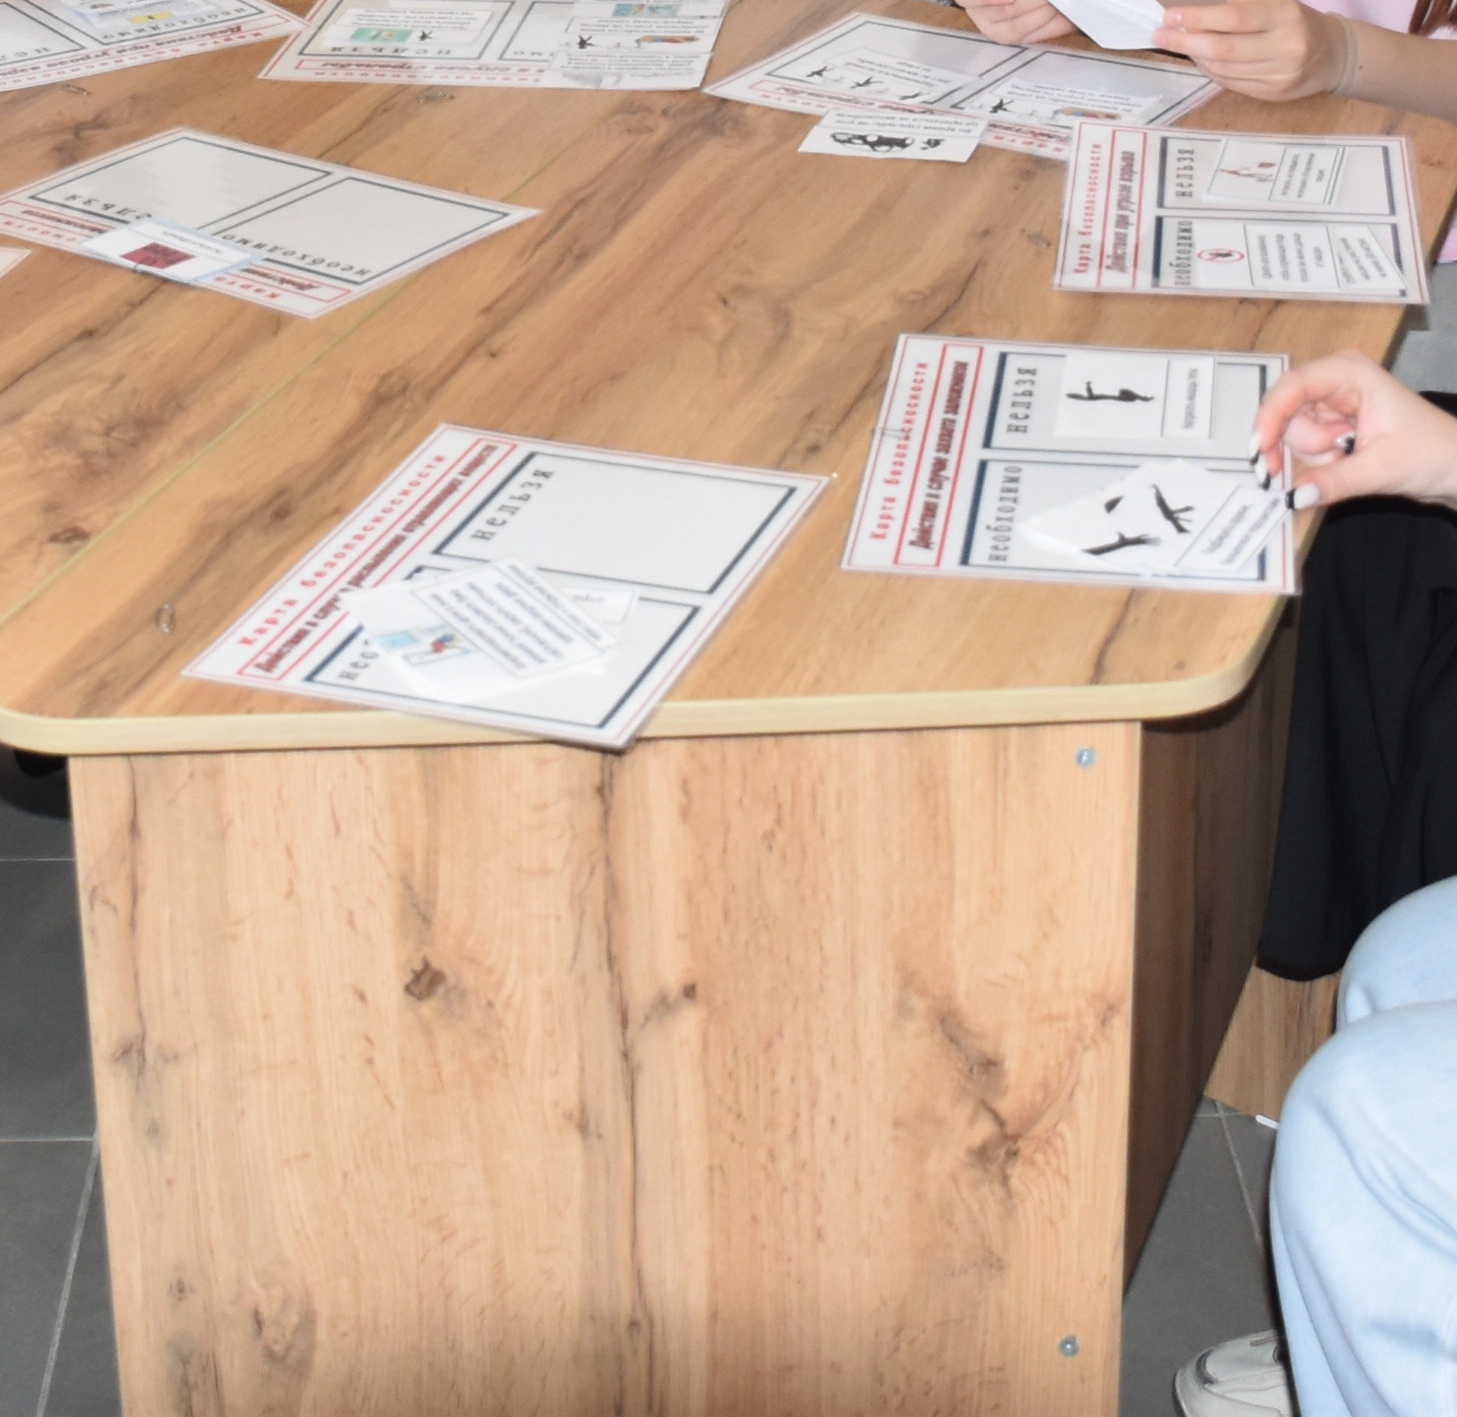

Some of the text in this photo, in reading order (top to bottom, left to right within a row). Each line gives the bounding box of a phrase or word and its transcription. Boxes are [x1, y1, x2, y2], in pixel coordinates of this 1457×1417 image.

[116, 44, 149, 54] при
[156, 24, 246, 46] Действия
[47, 49, 110, 67] угрозе
[1176, 149, 1195, 198] нельзя
[65, 195, 152, 219] ельзя
[1073, 243, 1092, 273] Карта
[1169, 221, 1193, 286] необходимо
[1007, 368, 1036, 433] нельзя
[472, 469, 553, 541] нельзя
[870, 497, 896, 540] Карта
[986, 466, 1022, 561] необходимо
[239, 599, 297, 645] Карта
